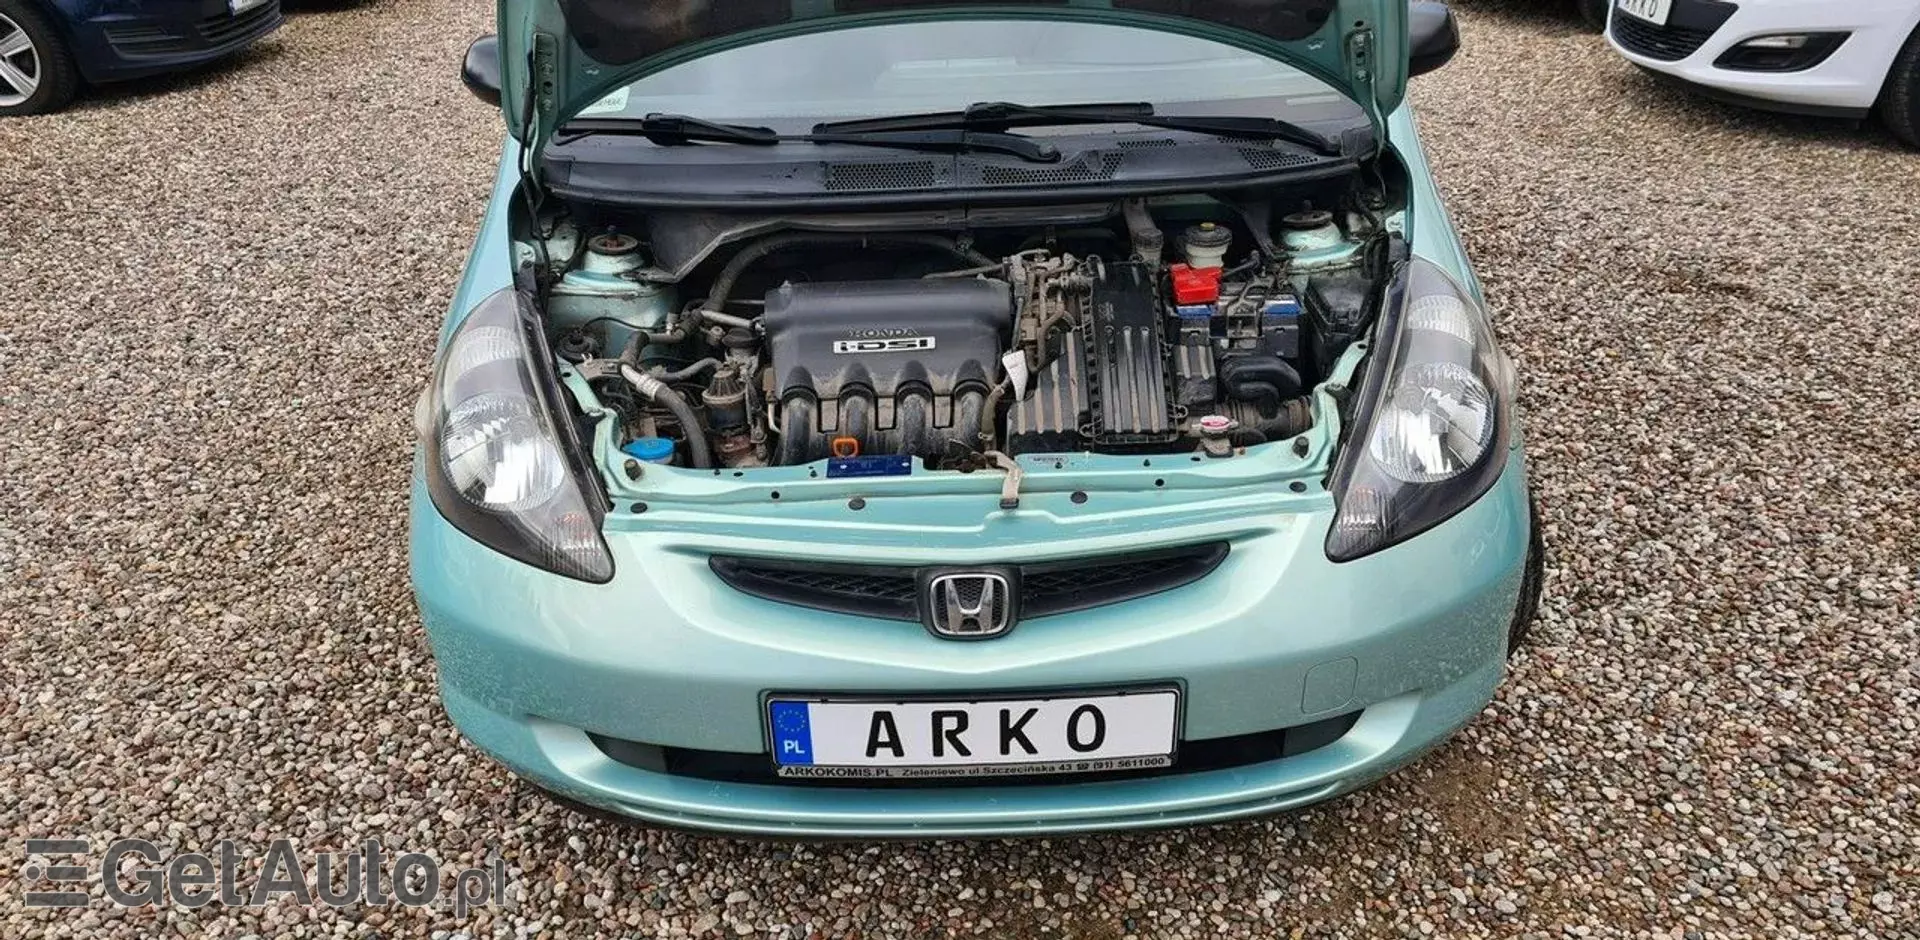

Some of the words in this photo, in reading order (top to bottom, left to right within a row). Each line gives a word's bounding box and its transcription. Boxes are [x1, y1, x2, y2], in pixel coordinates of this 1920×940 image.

[784, 741, 805, 754] PL
[785, 768, 893, 777] ARKOKOMIS.PL
[1058, 763, 1073, 772] 43
[1117, 757, 1165, 769] 5611000
